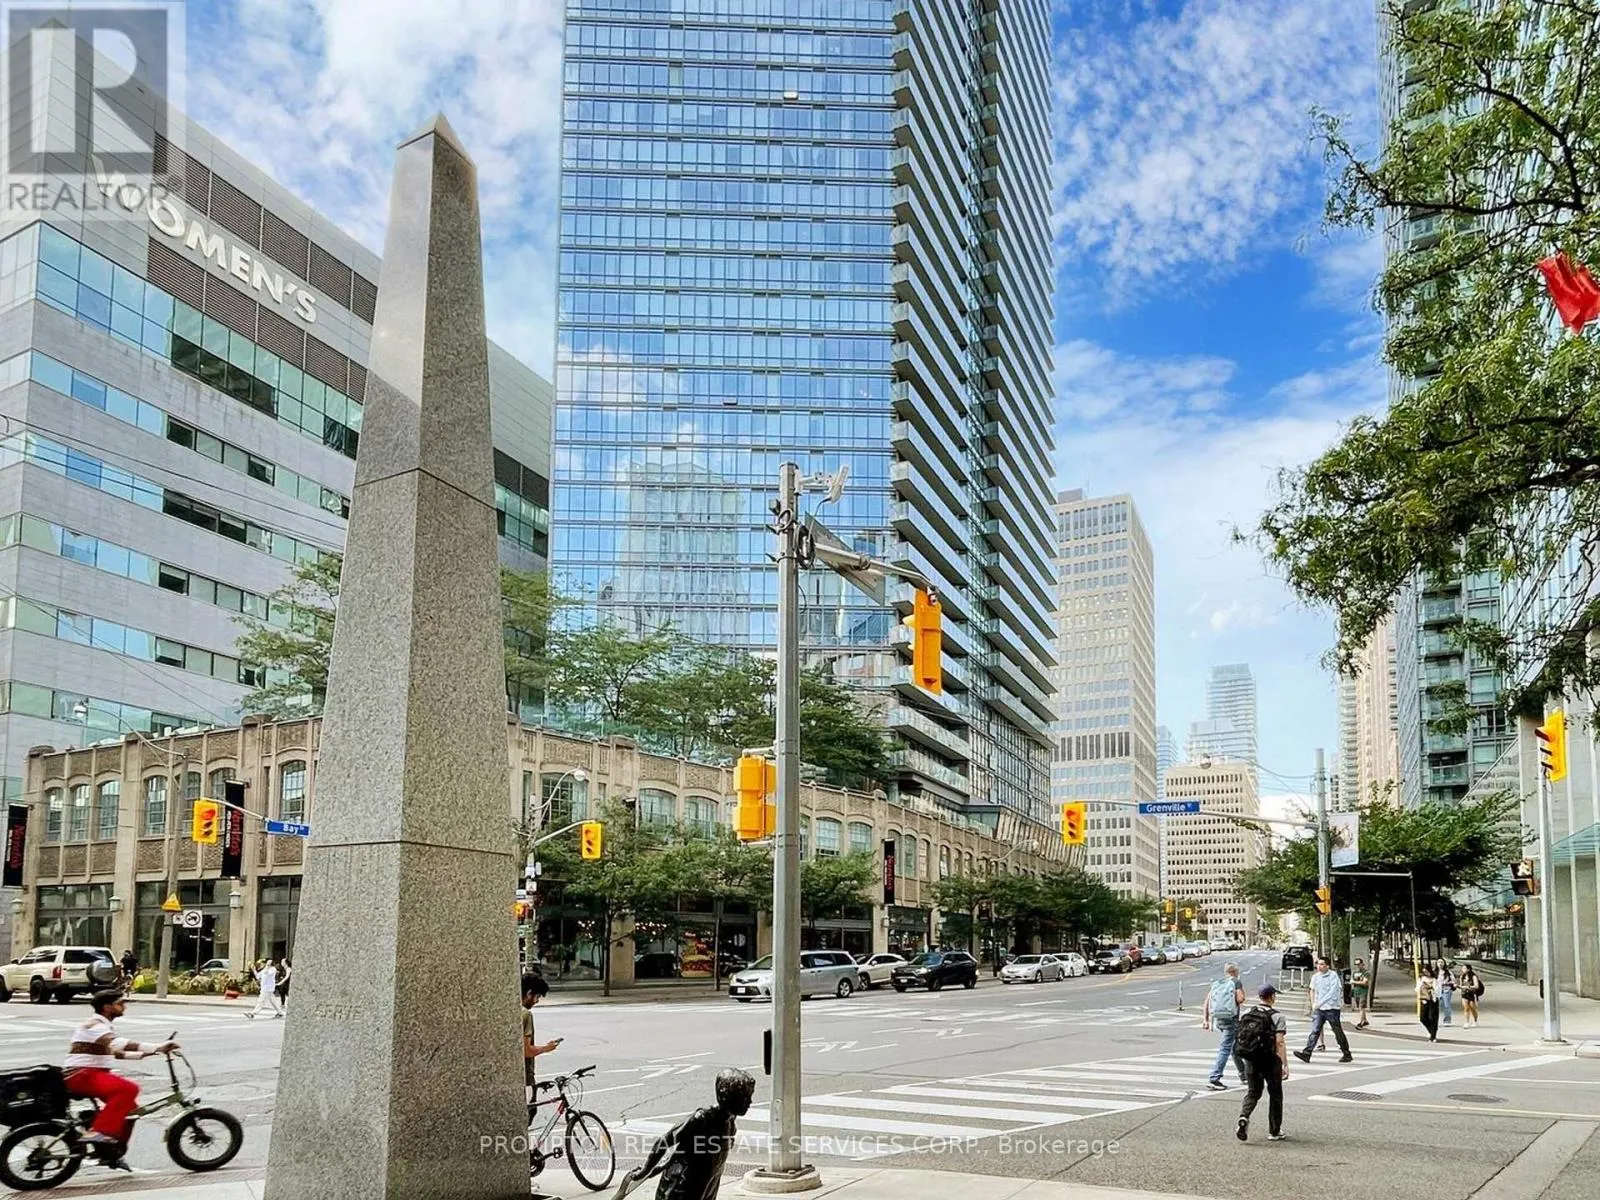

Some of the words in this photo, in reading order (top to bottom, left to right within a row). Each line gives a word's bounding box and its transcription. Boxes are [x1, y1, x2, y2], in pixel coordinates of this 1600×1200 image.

[91, 154, 318, 323] WOMEN'S
[1146, 803, 1186, 813] Grenville
[283, 823, 299, 835] Bay
